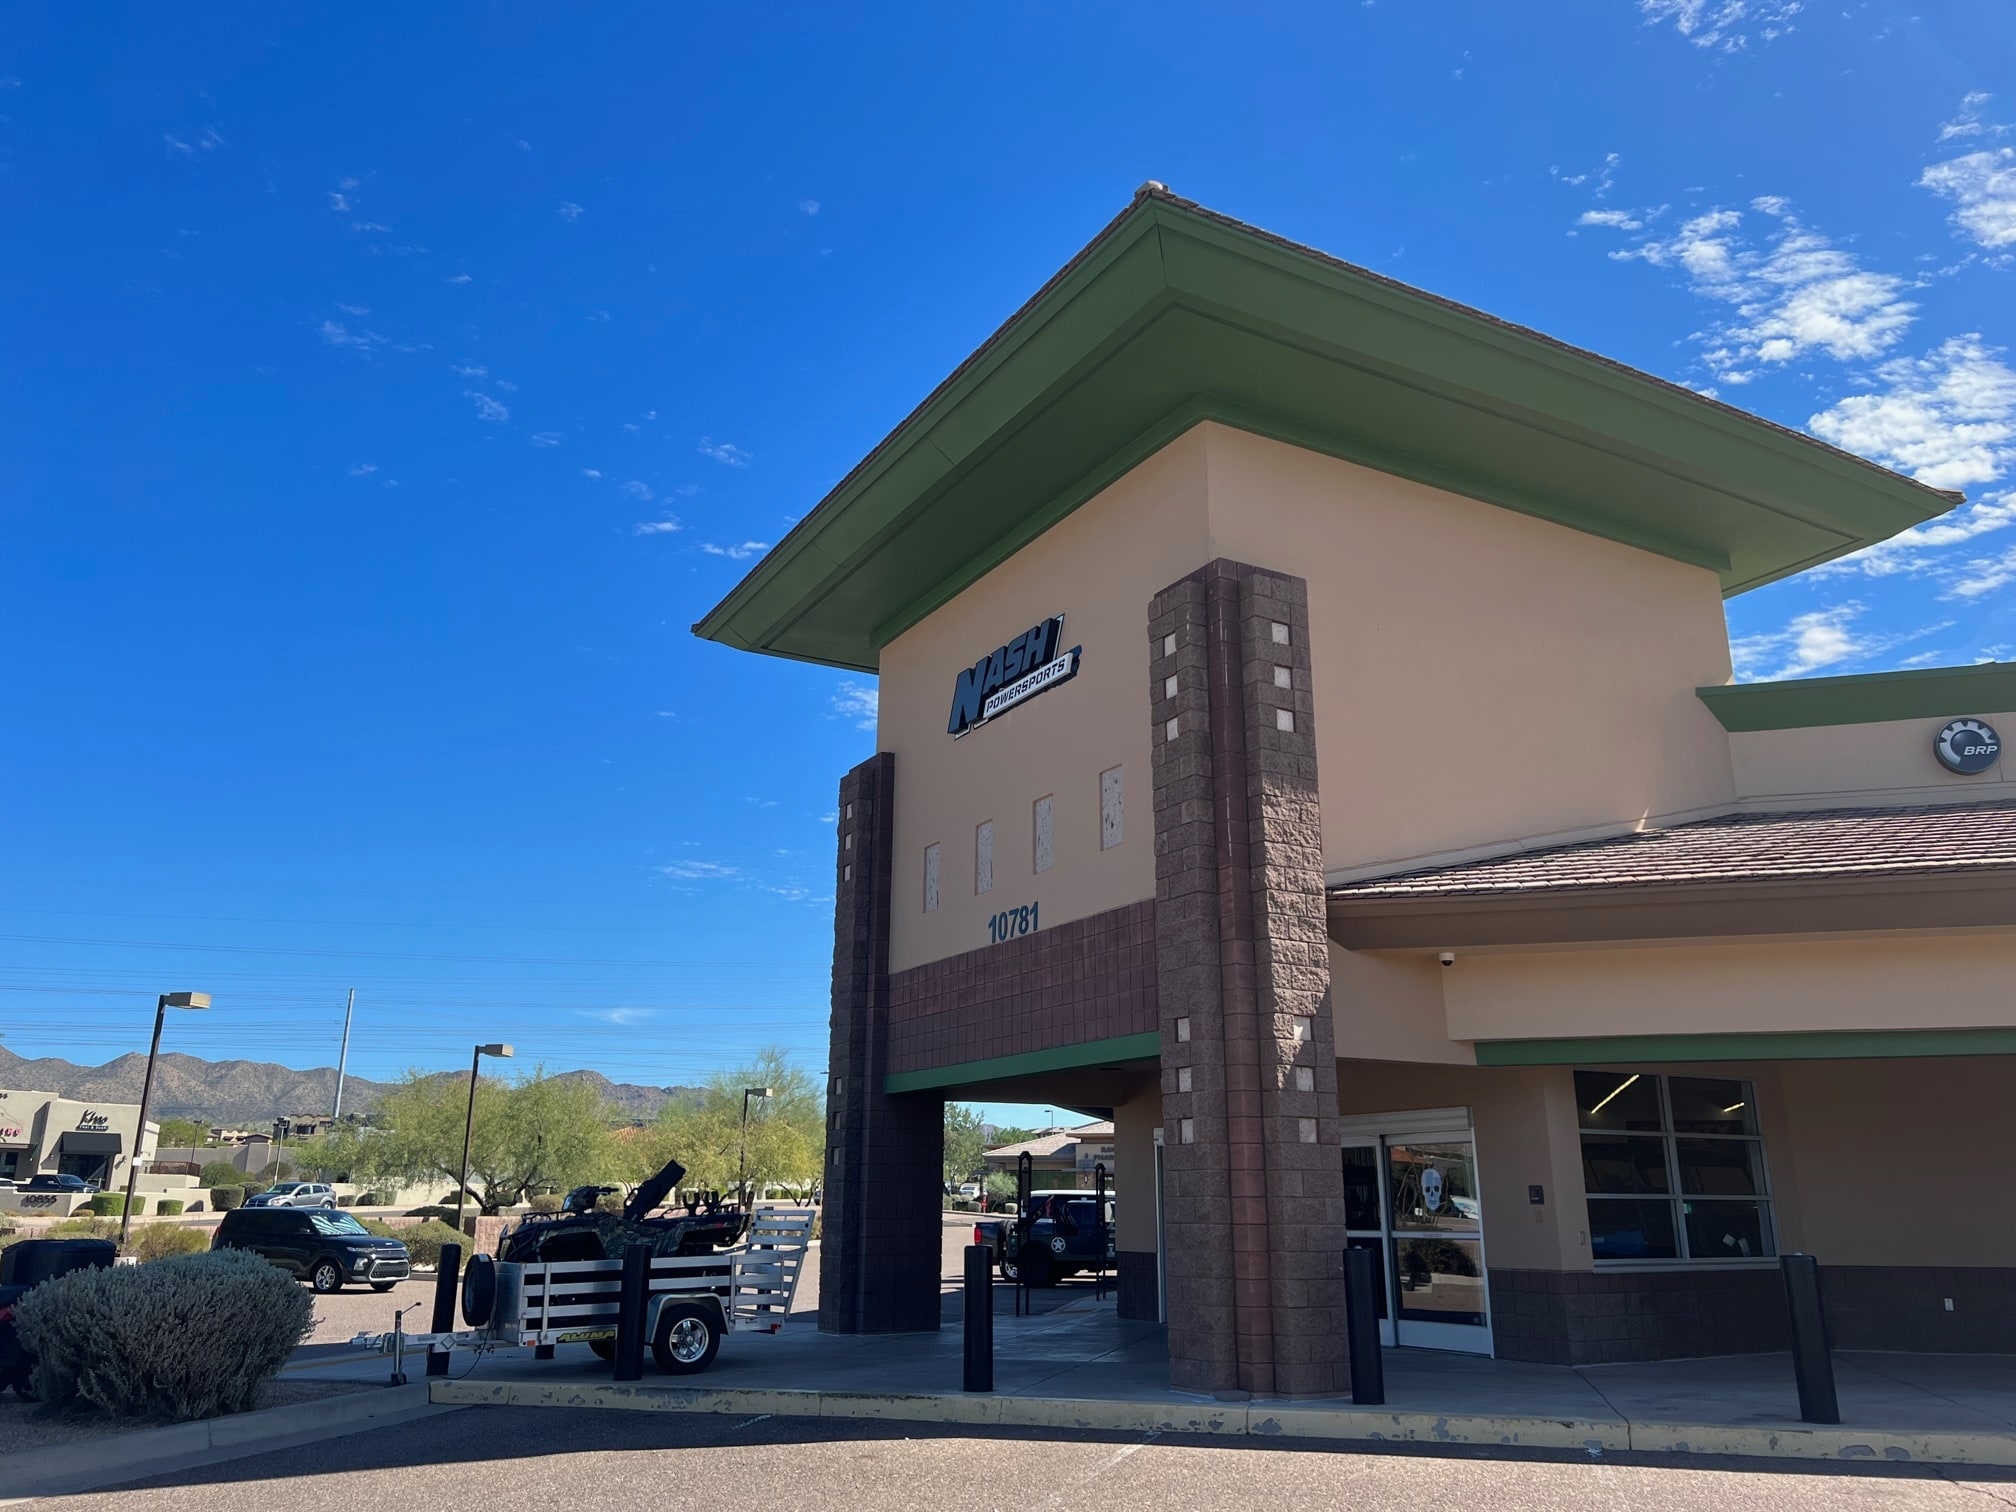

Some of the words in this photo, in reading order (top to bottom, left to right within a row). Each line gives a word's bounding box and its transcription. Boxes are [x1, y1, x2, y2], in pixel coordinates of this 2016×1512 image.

[947, 616, 1061, 734] NASH
[987, 658, 1067, 713] POWERSPORTS
[1964, 745, 1997, 755] BRP
[988, 900, 1038, 944] 10781
[24, 1194, 58, 1205] 10855
[558, 1330, 615, 1343] ALUMA
